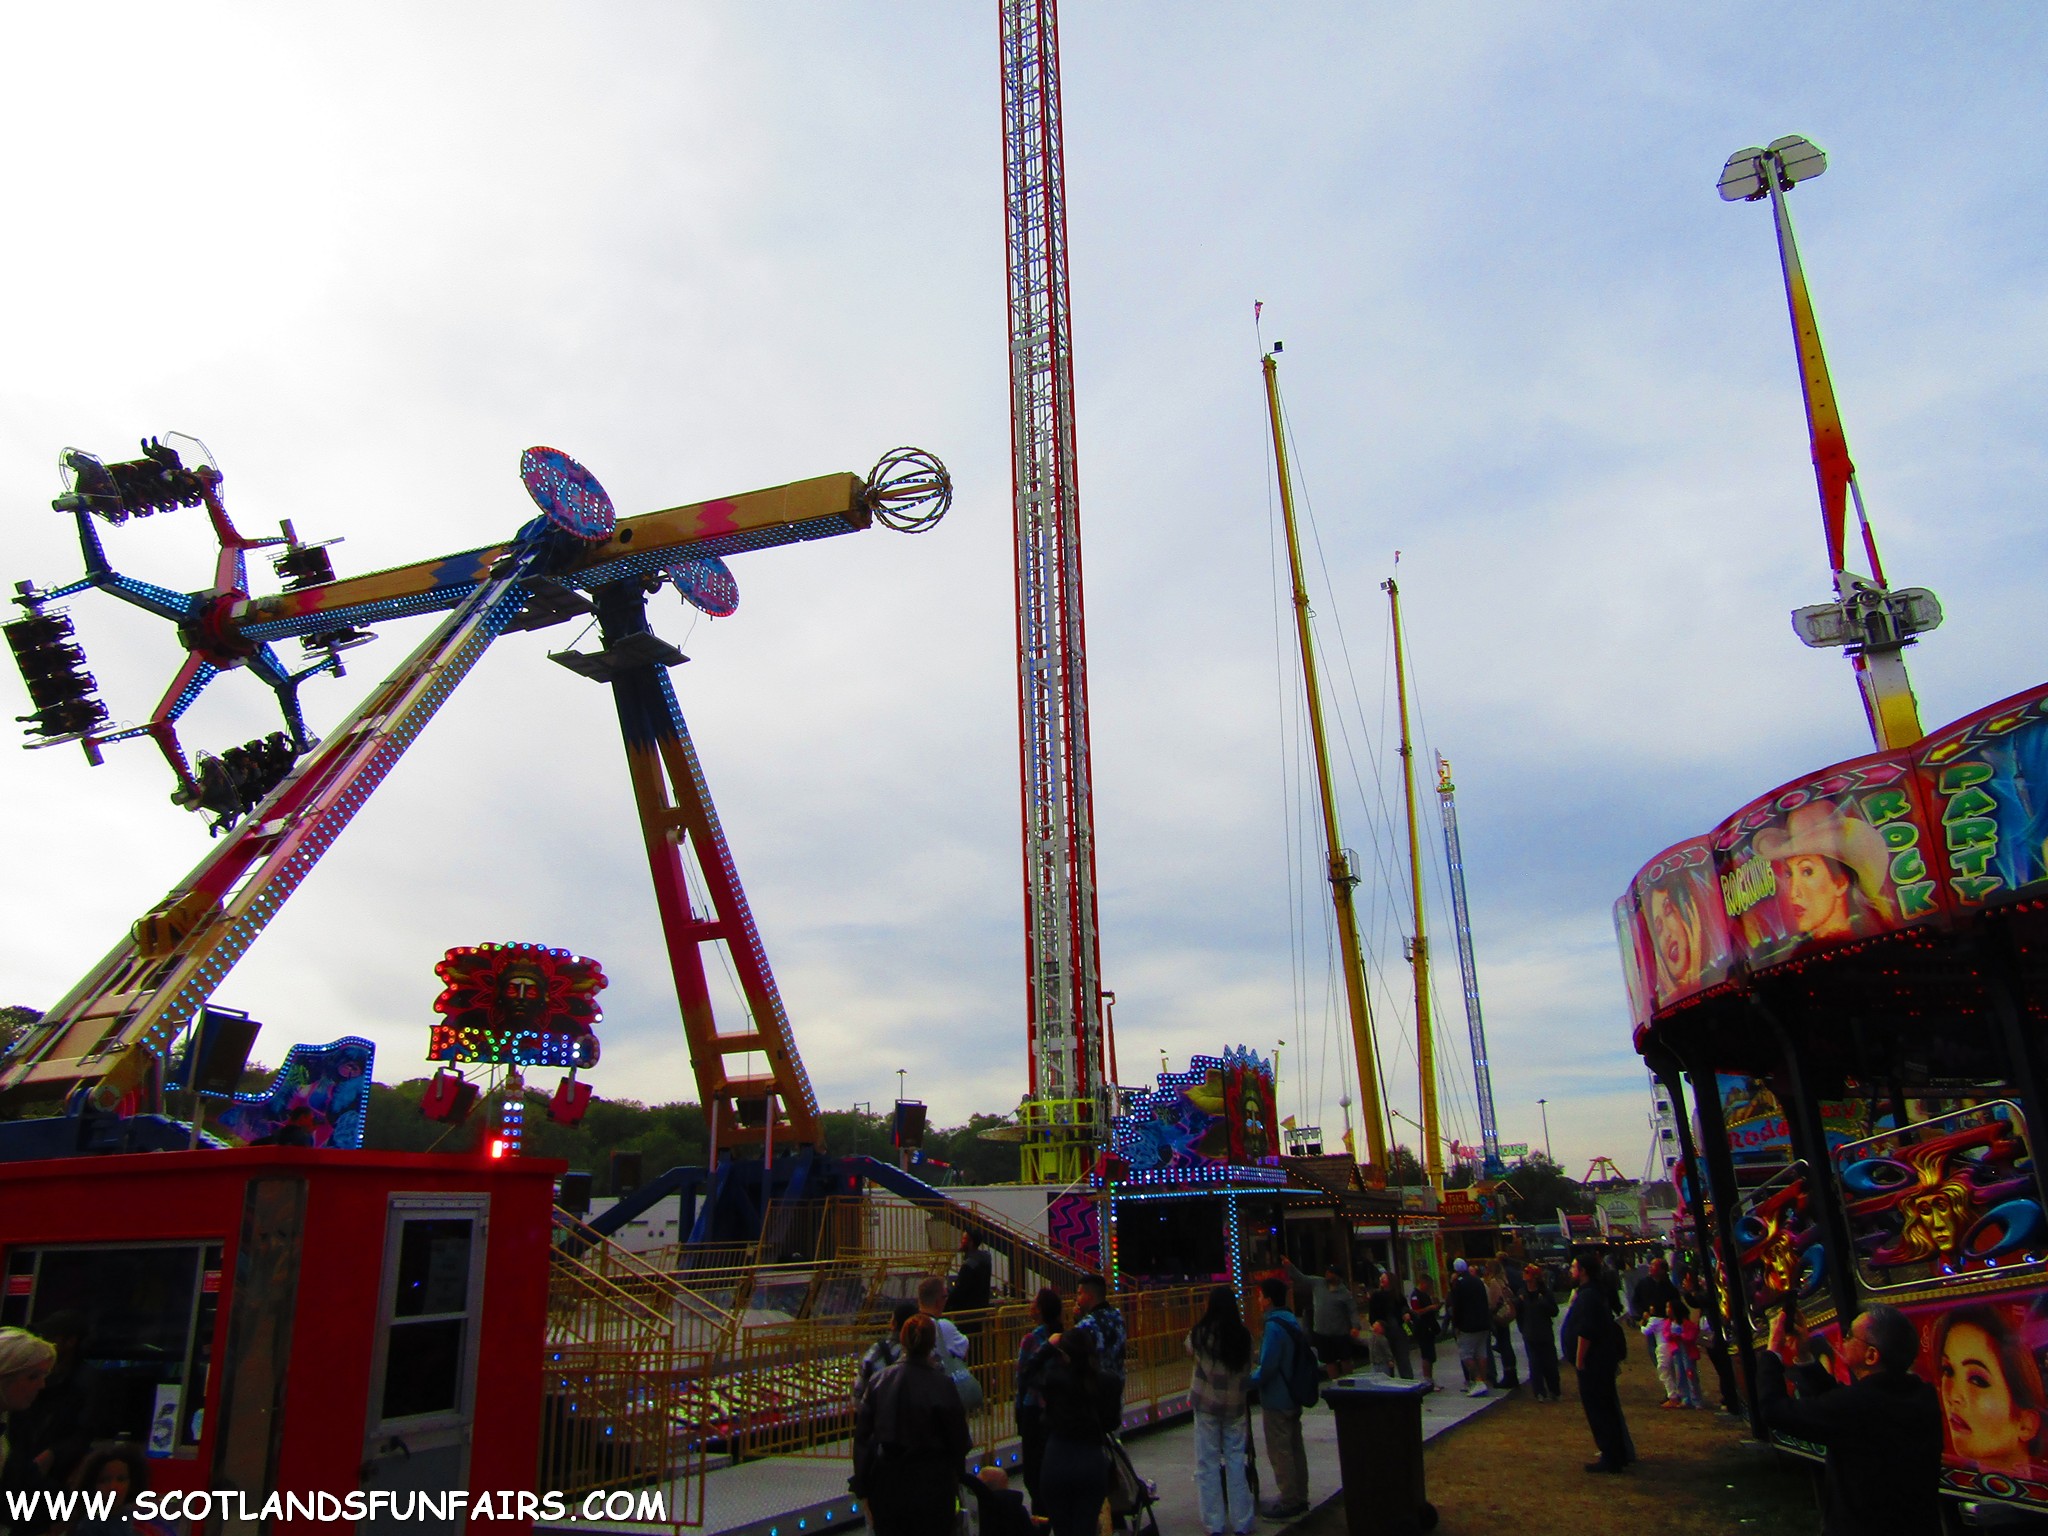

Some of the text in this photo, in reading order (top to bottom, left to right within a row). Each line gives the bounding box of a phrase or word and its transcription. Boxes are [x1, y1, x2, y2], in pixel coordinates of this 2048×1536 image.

[522, 451, 617, 534] PSYCHO
[1860, 762, 2003, 920] ROCK PARTY
